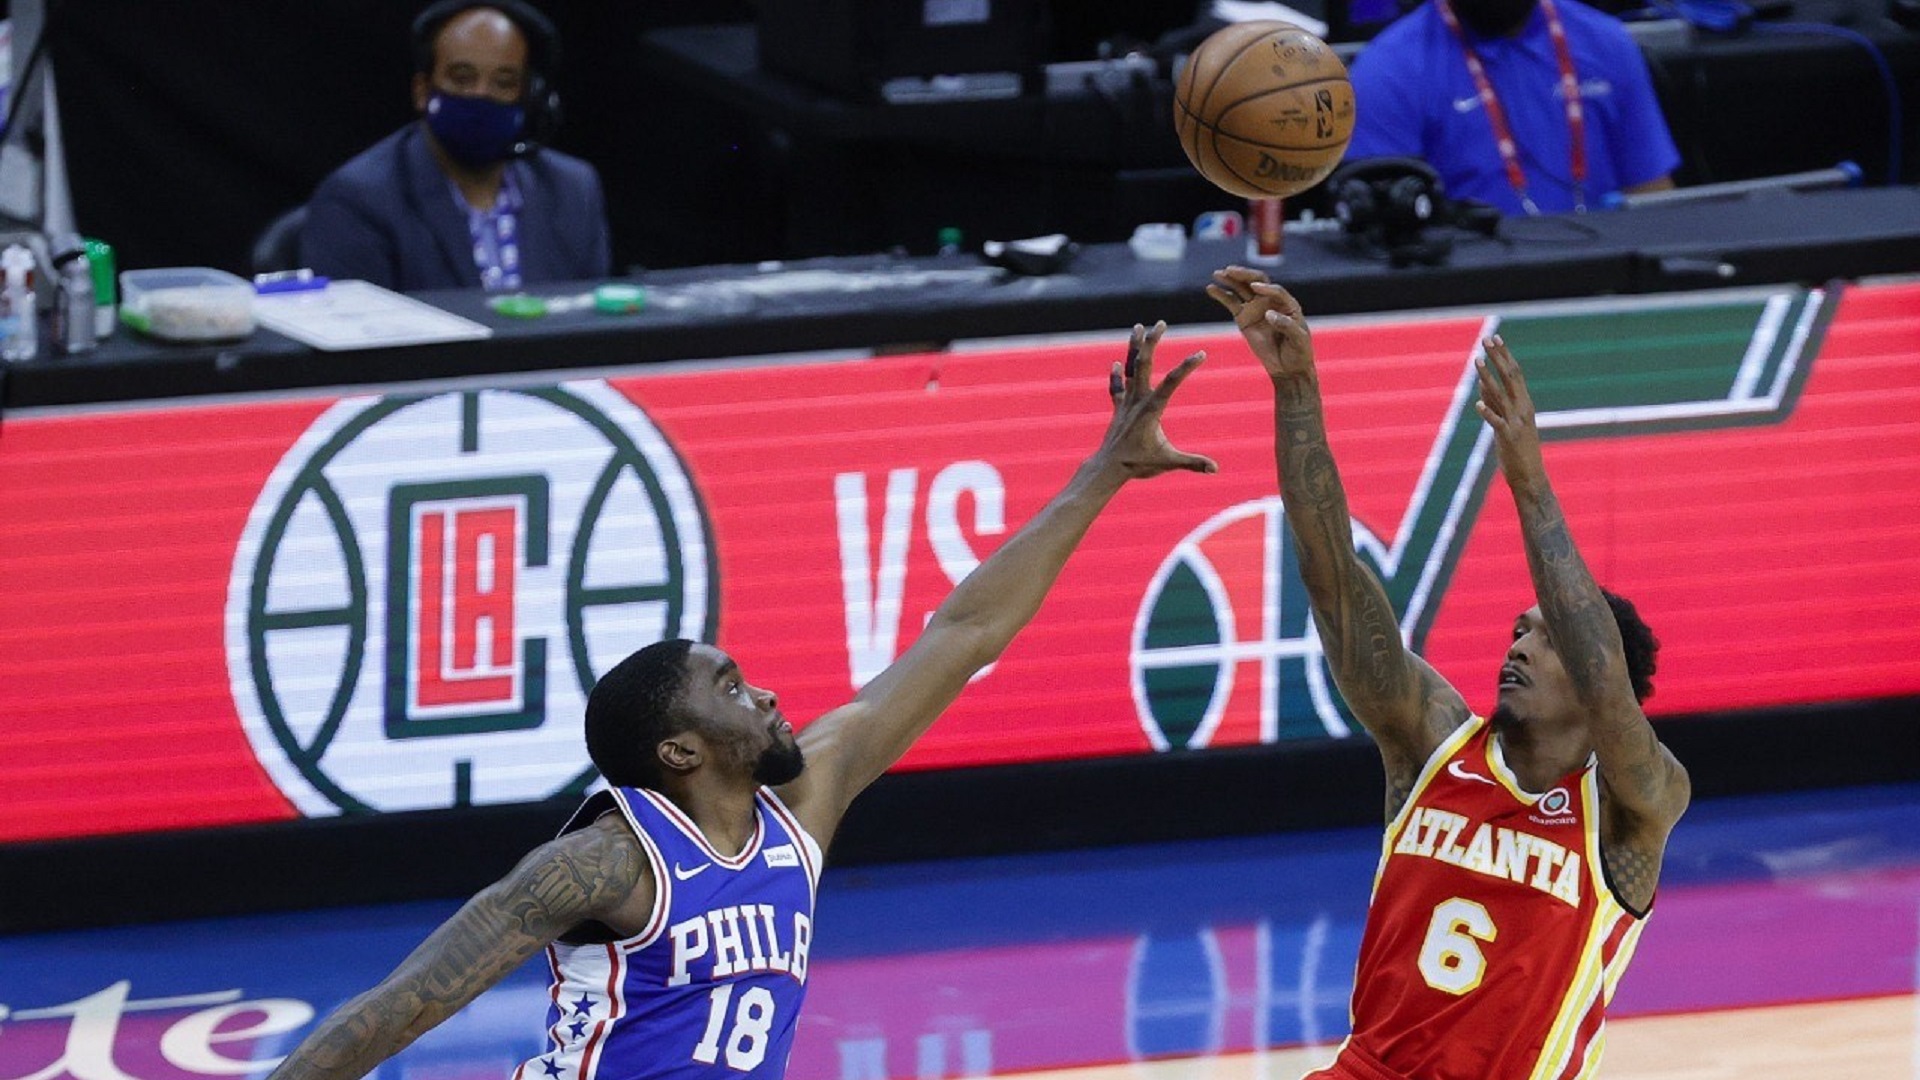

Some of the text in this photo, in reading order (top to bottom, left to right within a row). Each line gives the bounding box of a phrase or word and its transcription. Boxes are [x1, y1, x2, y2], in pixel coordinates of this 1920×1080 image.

[1394, 806, 1583, 910] ATLANTA
[1416, 896, 1499, 997] 6
[692, 982, 776, 1073] 18
